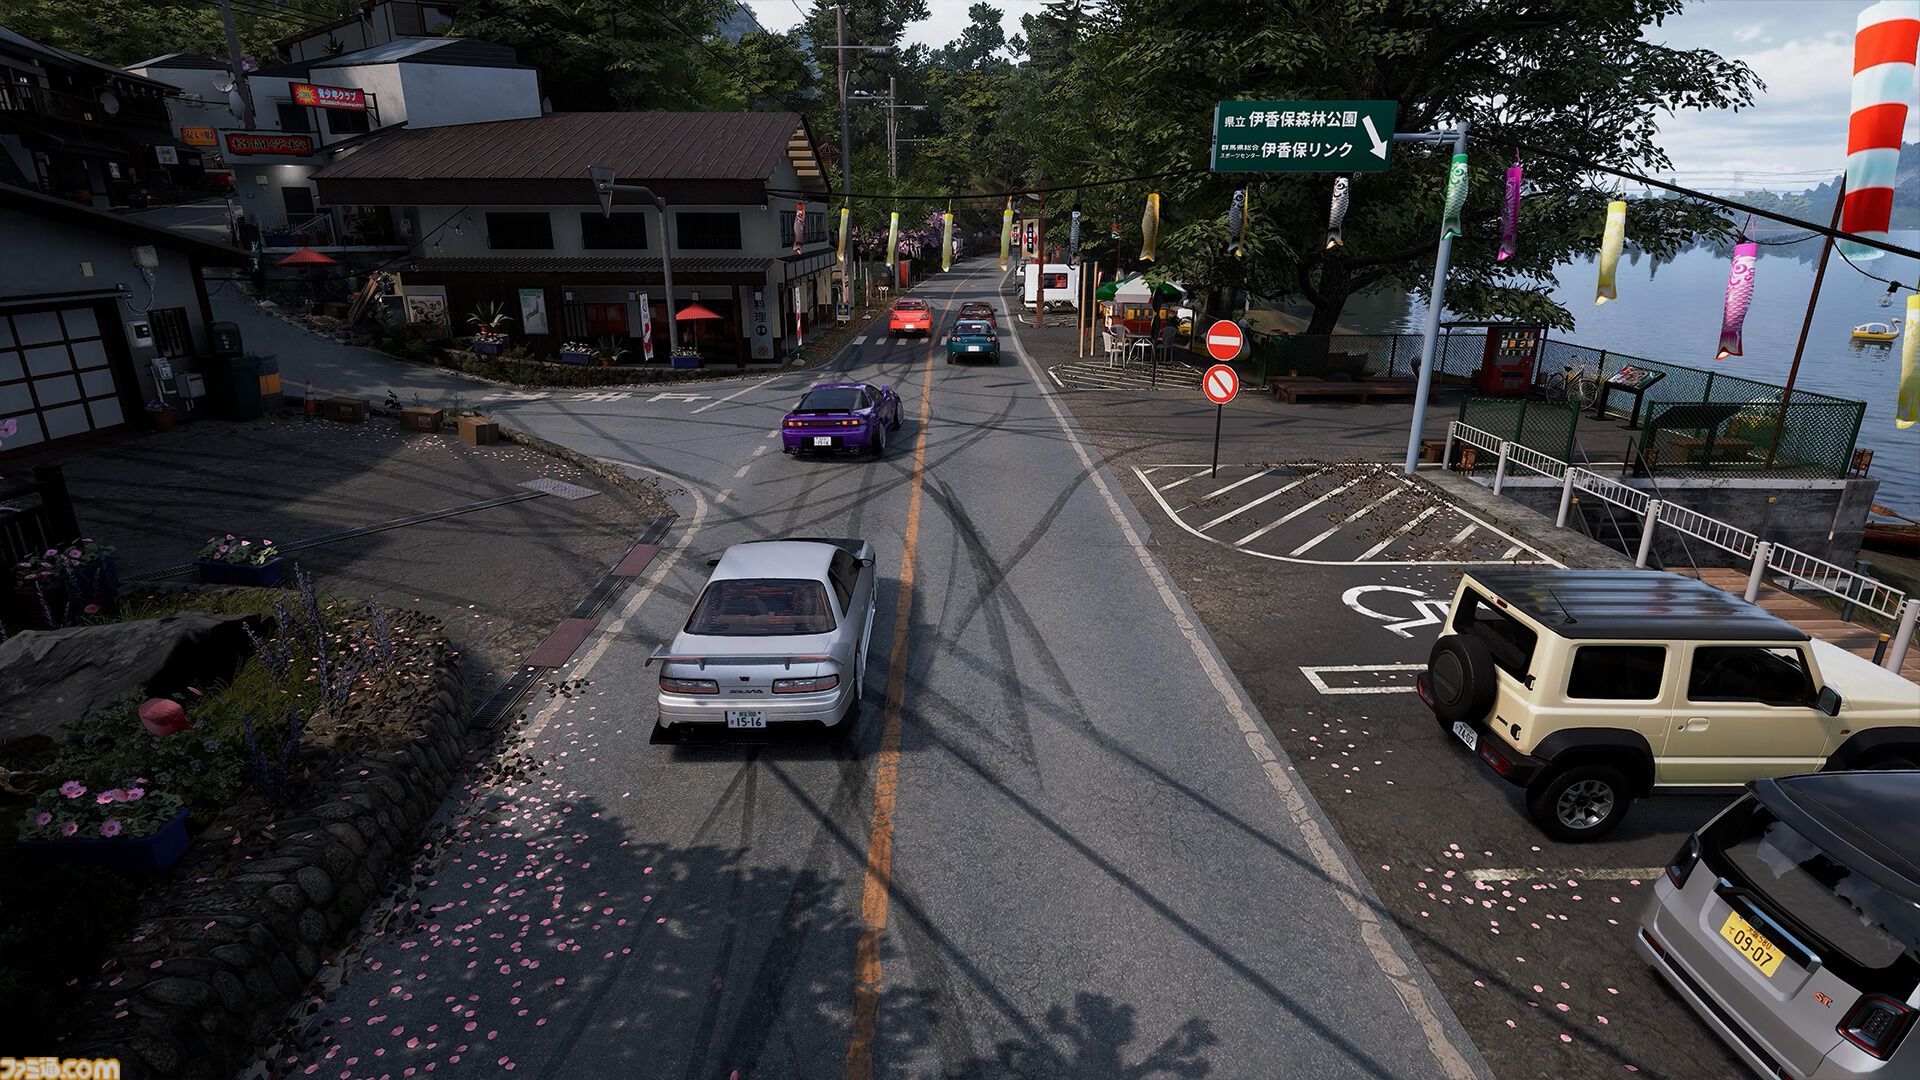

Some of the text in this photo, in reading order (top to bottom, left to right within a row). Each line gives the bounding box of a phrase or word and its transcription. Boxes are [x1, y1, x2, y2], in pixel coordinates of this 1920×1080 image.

[1224, 111, 1358, 128] 県立 伊香保森林公園
[1261, 142, 1353, 159] 伊香保リンク
[736, 717, 762, 727] 15-16
[1733, 930, 1773, 967] 09-07
